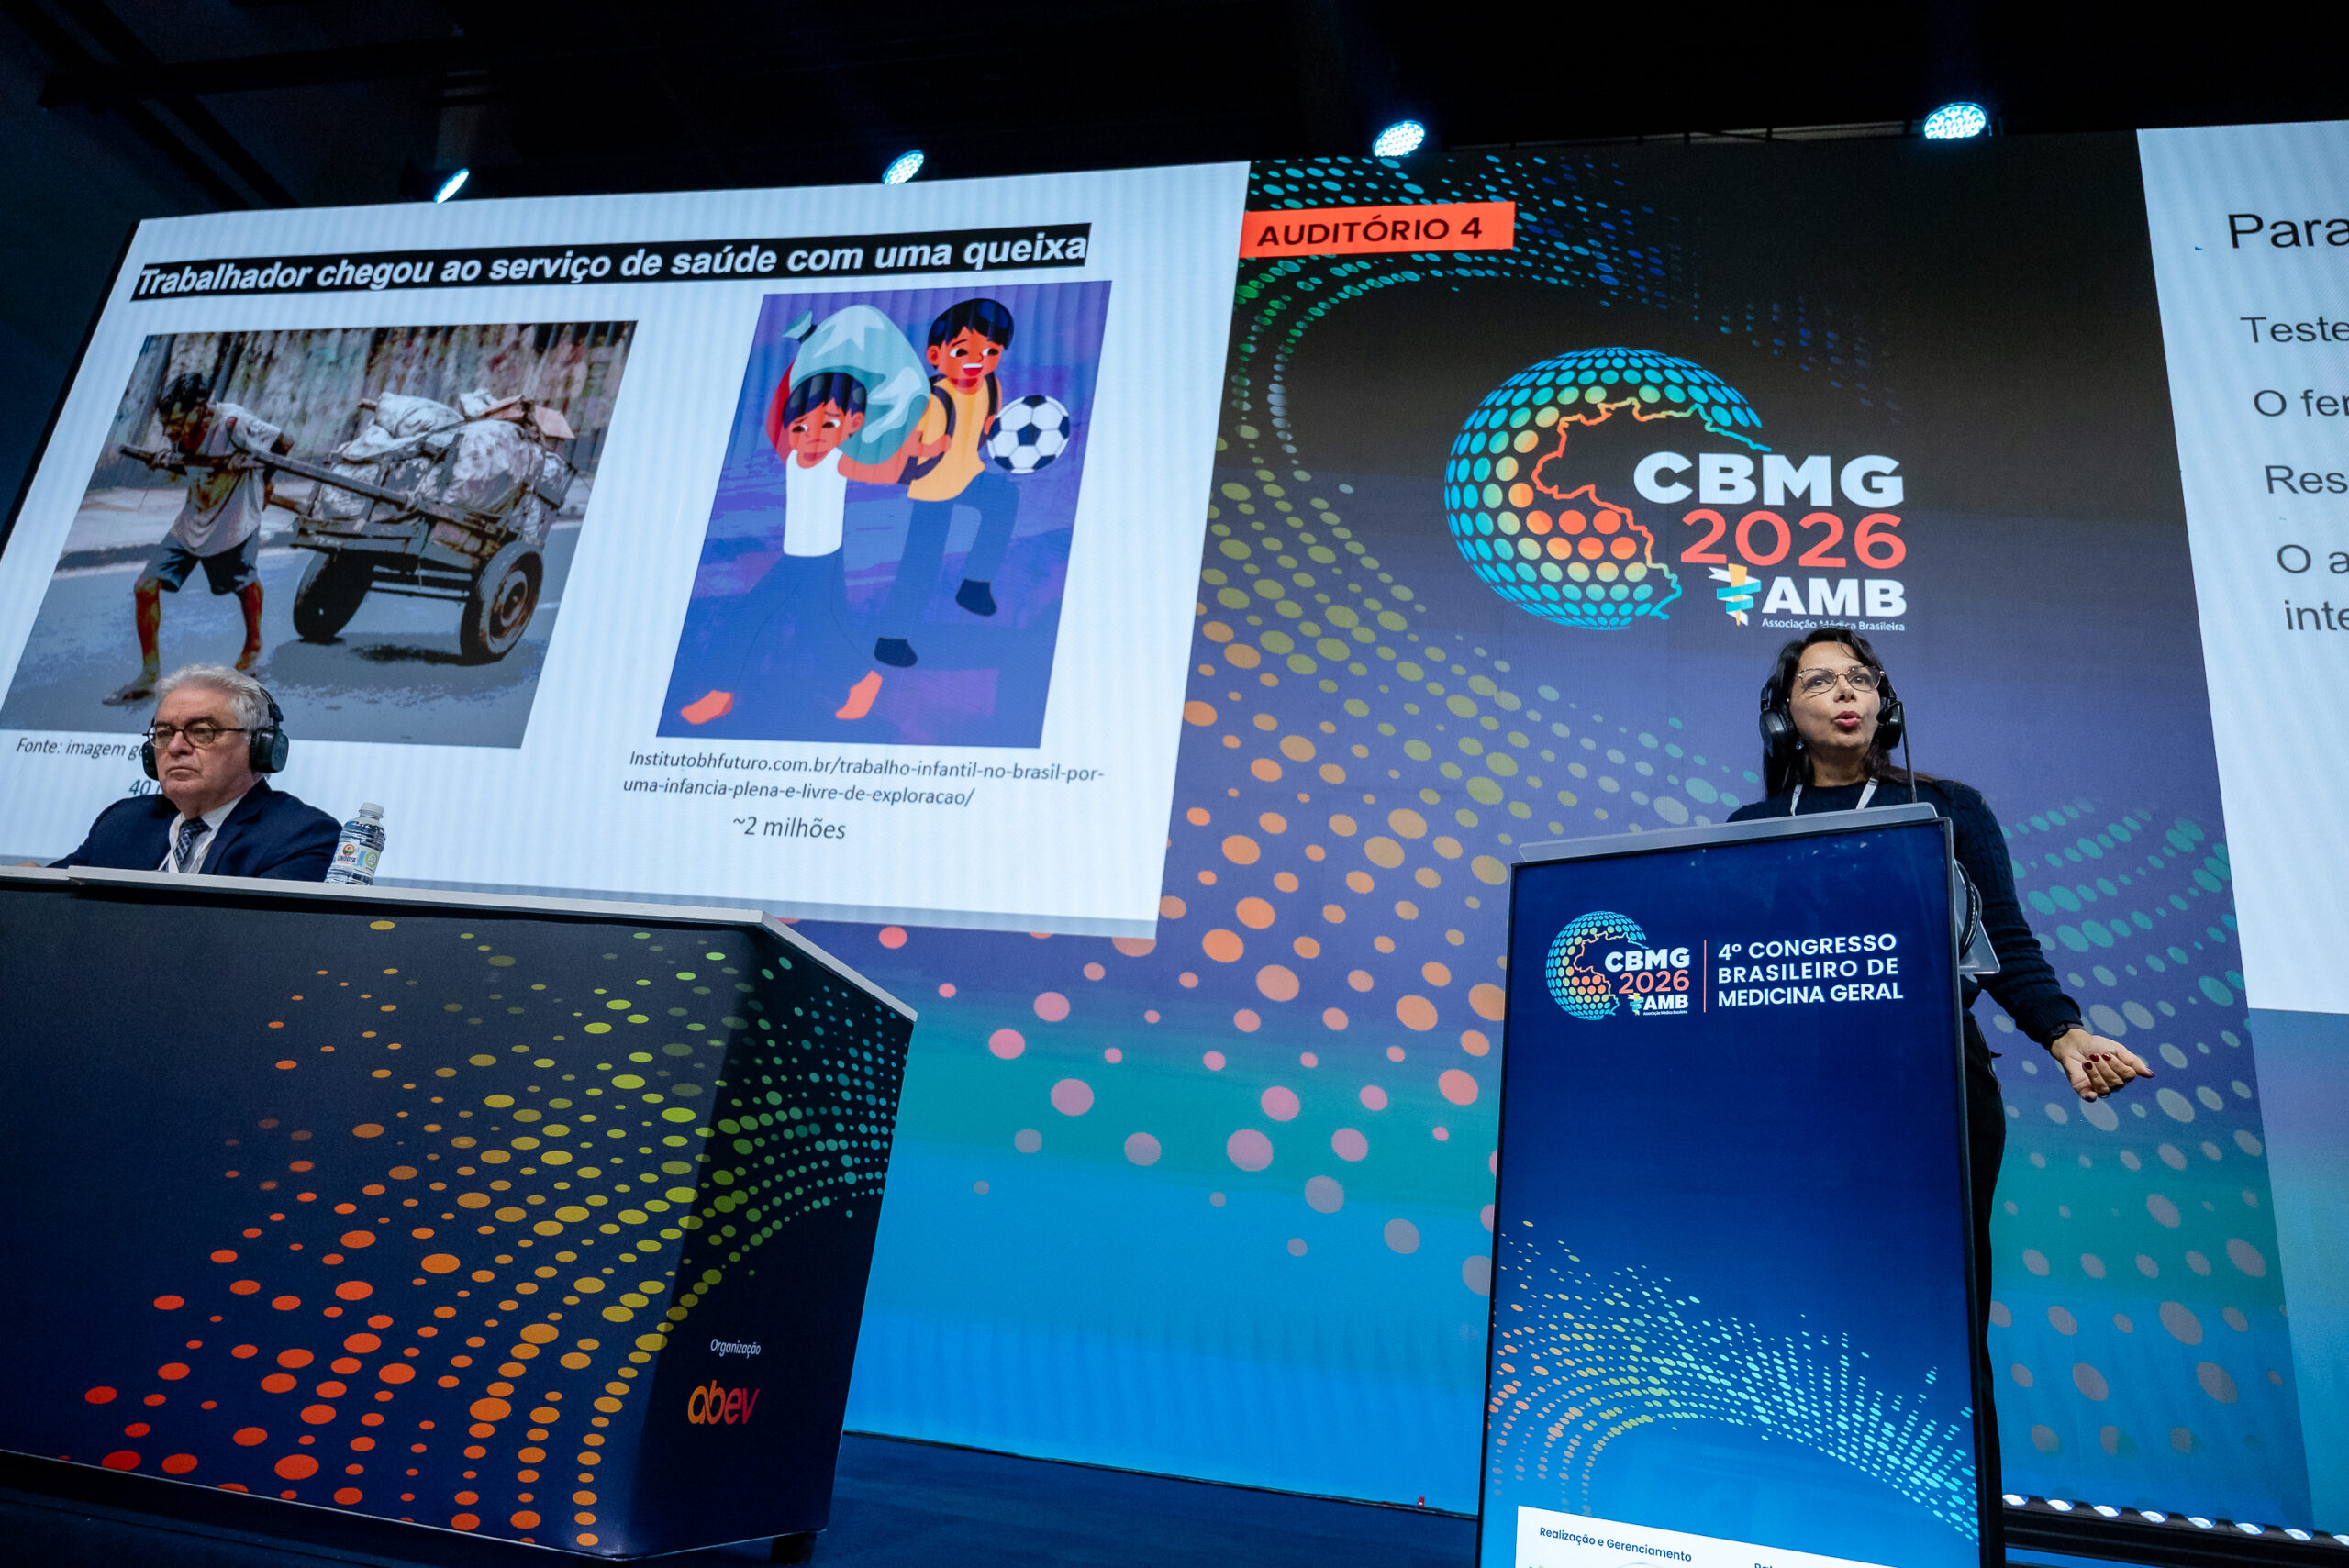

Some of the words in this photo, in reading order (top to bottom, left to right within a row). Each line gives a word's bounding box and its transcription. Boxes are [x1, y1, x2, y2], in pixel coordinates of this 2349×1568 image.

[1257, 215, 1449, 246] AUDITÓRIO
[1461, 217, 1482, 239] 4
[2228, 213, 2349, 249] Para
[139, 261, 312, 295] Trabalhador
[317, 258, 434, 290] chegou
[441, 259, 481, 282] ao
[489, 250, 611, 284] serviço
[621, 249, 662, 275] de
[671, 245, 777, 274] saúde
[786, 247, 863, 272] com
[874, 241, 952, 268] uma
[963, 231, 1086, 270] queixa
[2254, 389, 2287, 417] O
[1633, 450, 1904, 508] CBMG
[1680, 509, 1907, 569] 2026
[2277, 544, 2311, 573] O
[1762, 576, 1907, 617] AMB
[1762, 618, 1816, 630] Associação
[1859, 621, 1905, 631] Brasileira
[16, 737, 62, 754] Fonte:
[65, 739, 126, 759] imagem
[629, 751, 1105, 784] Institutobhfuturo.com.br/trabalho-infantil-no-brasil-por-
[129, 779, 152, 796] 40
[623, 778, 975, 806] uma-infancia-plena-e-livre-de-exploracao/
[733, 814, 759, 836] ~2
[763, 817, 846, 840] milhões
[1605, 947, 1690, 973] CBMG
[1748, 933, 1897, 959] CONGRESSO
[1619, 969, 1689, 994] 2026
[1718, 960, 1858, 984] BRASILEIRO
[1867, 957, 1898, 976] DE
[1643, 994, 1688, 1010] AMB
[1718, 986, 1825, 1007] MEDICINA
[1830, 982, 1904, 1002] GERAL
[710, 1338, 762, 1359] Organização
[687, 1379, 761, 1425] abev
[1540, 1527, 1596, 1546] Realização
[1606, 1538, 1692, 1562] Gerenciamento
